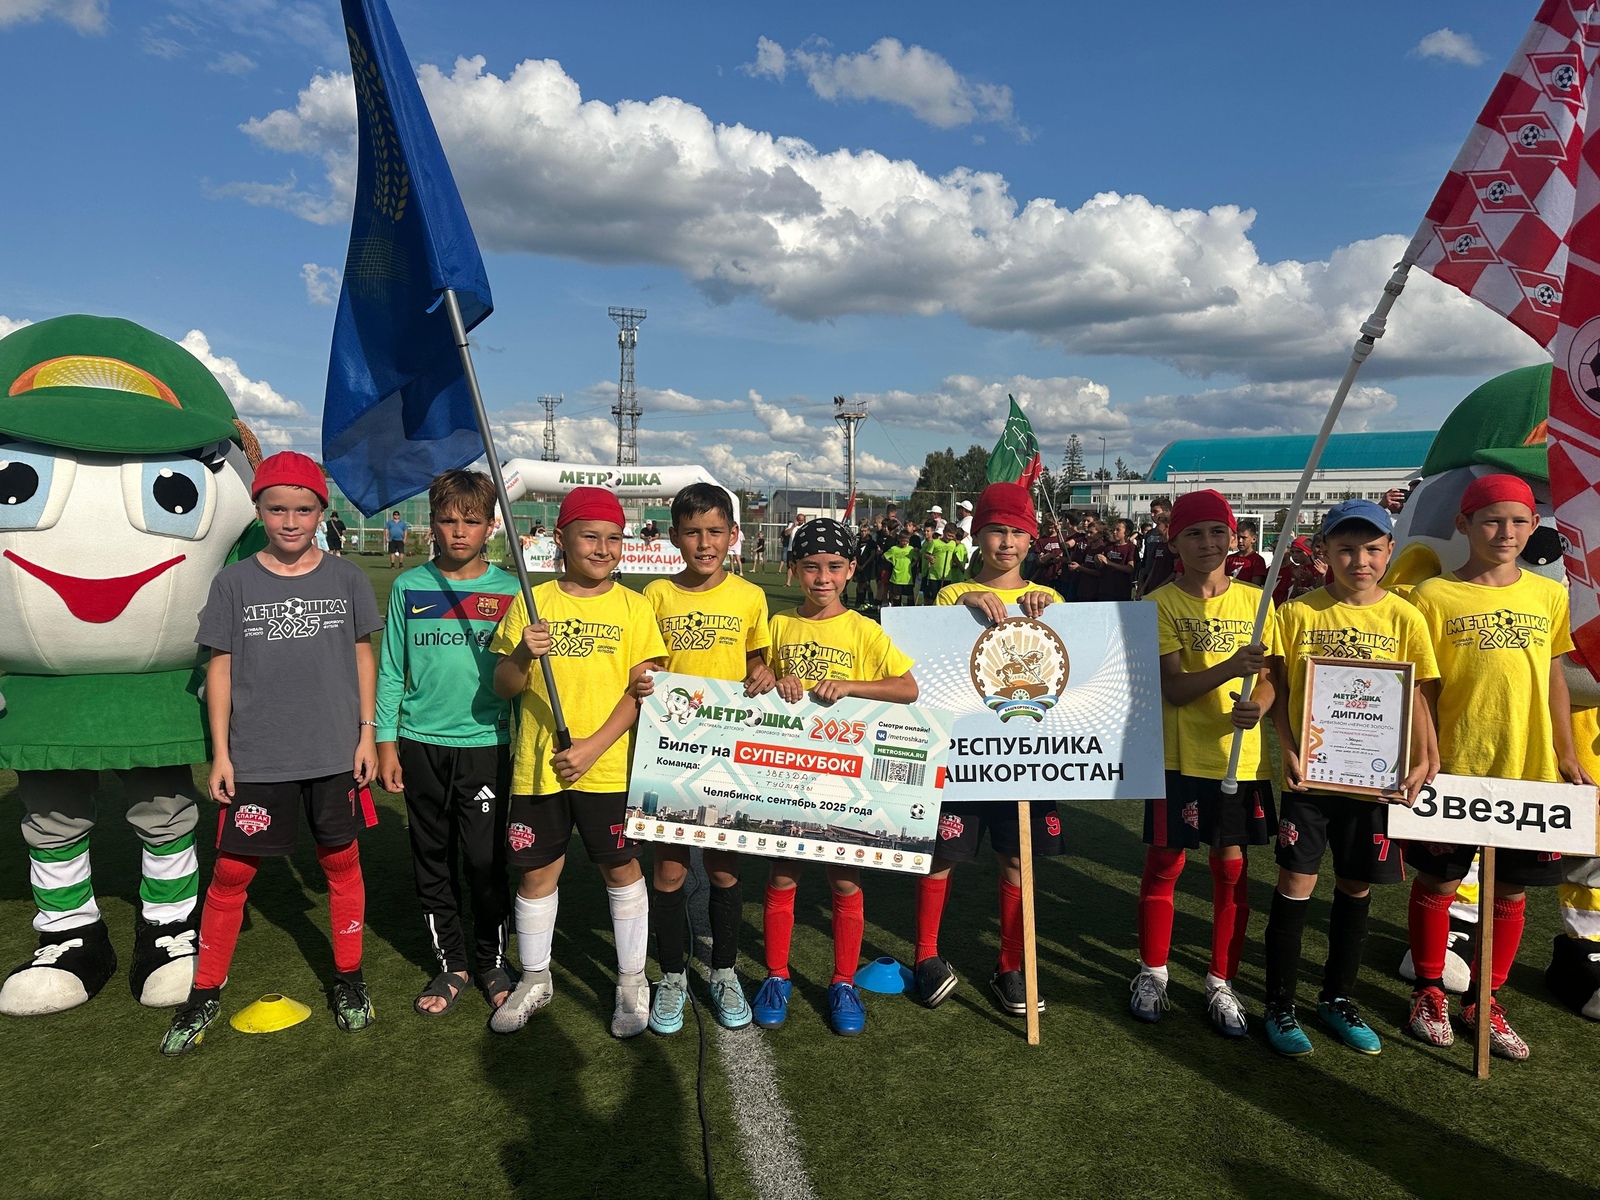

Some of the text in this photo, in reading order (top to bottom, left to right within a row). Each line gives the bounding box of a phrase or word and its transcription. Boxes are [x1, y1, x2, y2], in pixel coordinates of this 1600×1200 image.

[559, 469, 661, 488] МЕТРОШКА
[622, 543, 661, 552] ЛЬНАЯ
[620, 554, 685, 565] ИФИКАЦИ
[268, 616, 320, 640] 2025
[548, 618, 621, 641] ТРОШКА
[1446, 609, 1548, 635] МЕТРОШКА
[414, 628, 472, 646] unicef
[671, 630, 716, 651] 2025
[1191, 633, 1234, 652] 2025
[1479, 628, 1530, 649] 2025
[548, 637, 594, 657] 2025
[788, 659, 828, 680] 2025
[1345, 700, 1368, 709] 2025
[695, 704, 867, 745] МЕТРОШКА 2025
[878, 721, 904, 730] Смотри
[1331, 710, 1383, 722] ДИПЛОМ
[755, 729, 780, 737] ДВОРОВОГО
[888, 734, 929, 744] /metroshkaru
[658, 736, 856, 774] Билет на СУПЕРКУБОК!
[877, 748, 925, 758] METROSHKA.RU
[656, 756, 700, 770] Команда:
[944, 762, 1124, 783] АШКОРТОСТАН
[481, 802, 490, 813] 8
[703, 786, 873, 816] Челябинск, сентябрь 2025 года
[1412, 785, 1572, 833] Звезда
[237, 813, 268, 822] СПАРТАК
[1045, 811, 1061, 836] 9
[1373, 833, 1390, 861] 7
